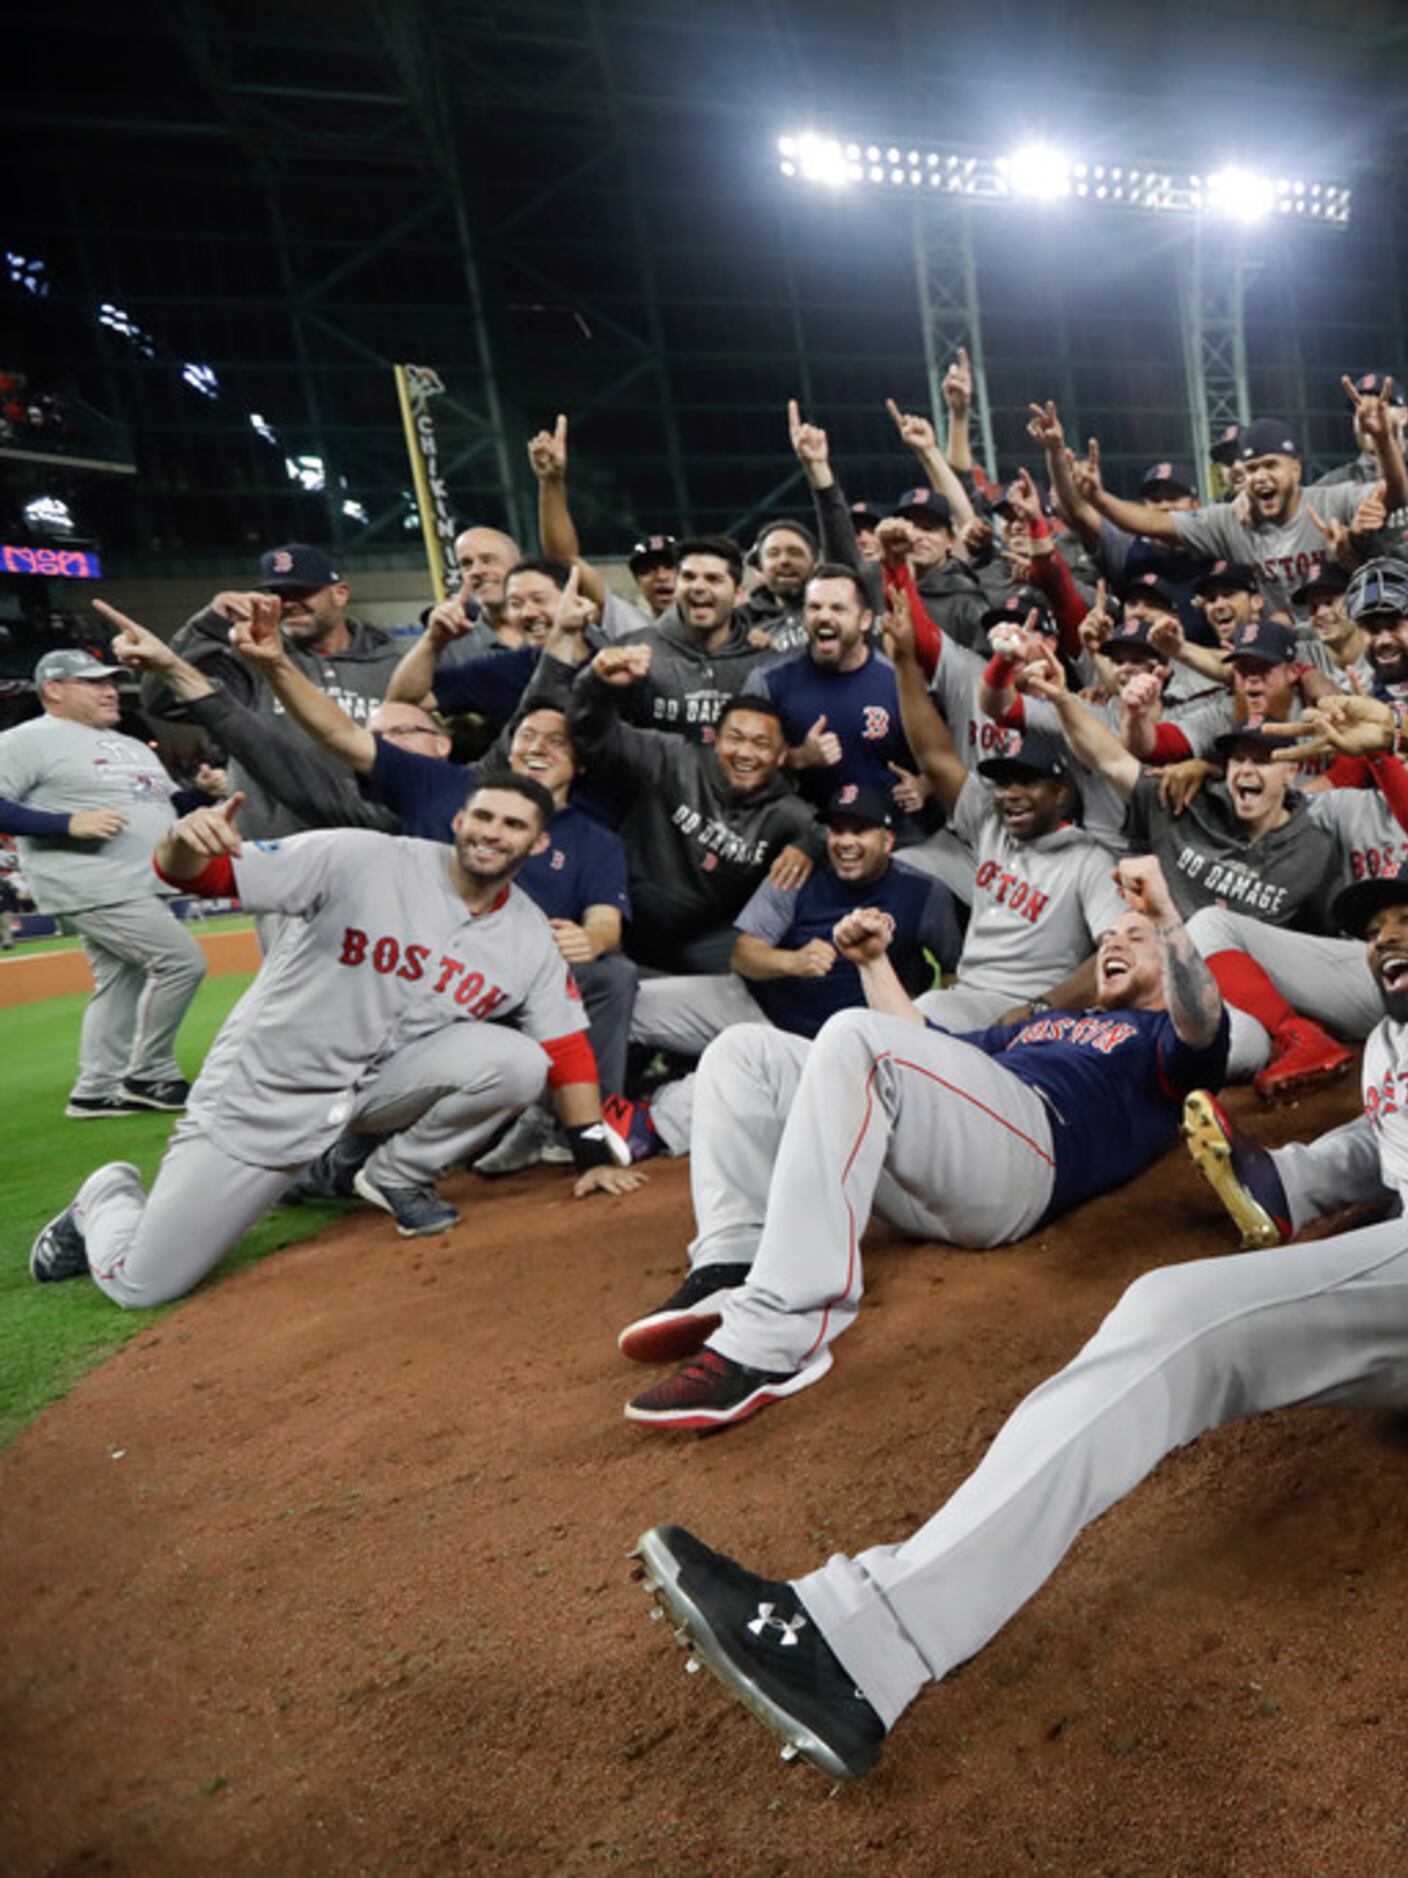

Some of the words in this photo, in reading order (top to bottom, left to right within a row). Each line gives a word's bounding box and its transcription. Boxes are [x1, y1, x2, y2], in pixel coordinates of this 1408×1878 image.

[416, 415, 455, 538] CHIKIN
[862, 706, 890, 740] B
[672, 803, 701, 834] DO
[1177, 846, 1205, 878] DO
[1203, 865, 1288, 911] DAMAGE
[338, 926, 511, 1021] BOSTON
